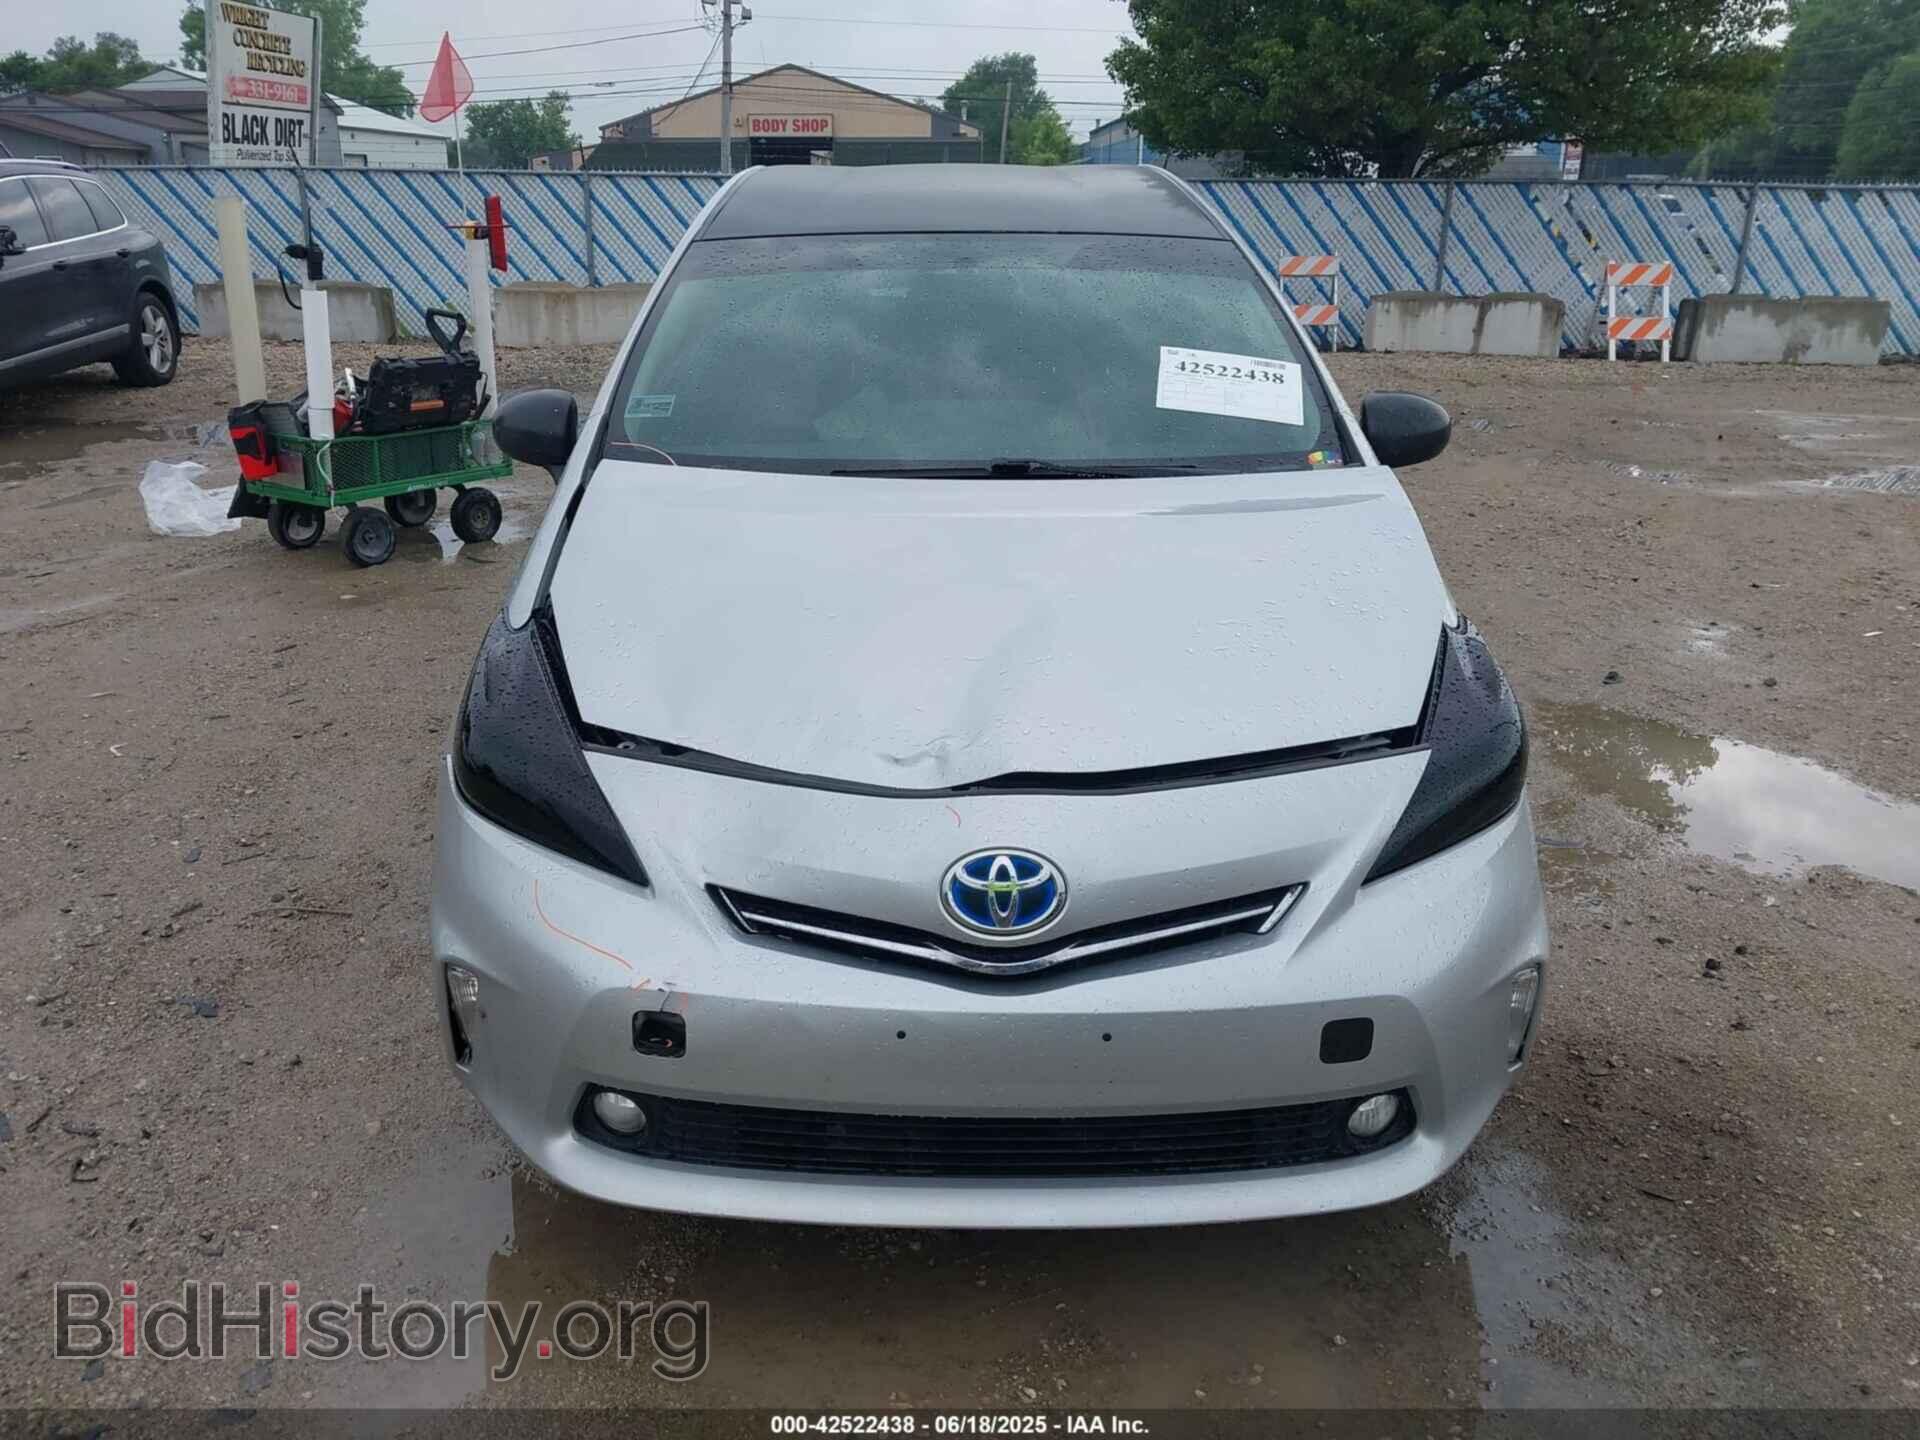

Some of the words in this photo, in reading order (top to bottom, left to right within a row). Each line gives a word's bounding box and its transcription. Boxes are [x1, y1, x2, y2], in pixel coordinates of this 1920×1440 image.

[233, 27, 291, 55] CONCRETE
[246, 51, 305, 78] RECYCLING
[222, 112, 270, 146] BLACK
[275, 117, 304, 147] DIRT
[752, 118, 788, 132] BODY
[792, 118, 829, 132] SHOP
[1175, 360, 1285, 384] 42522438
